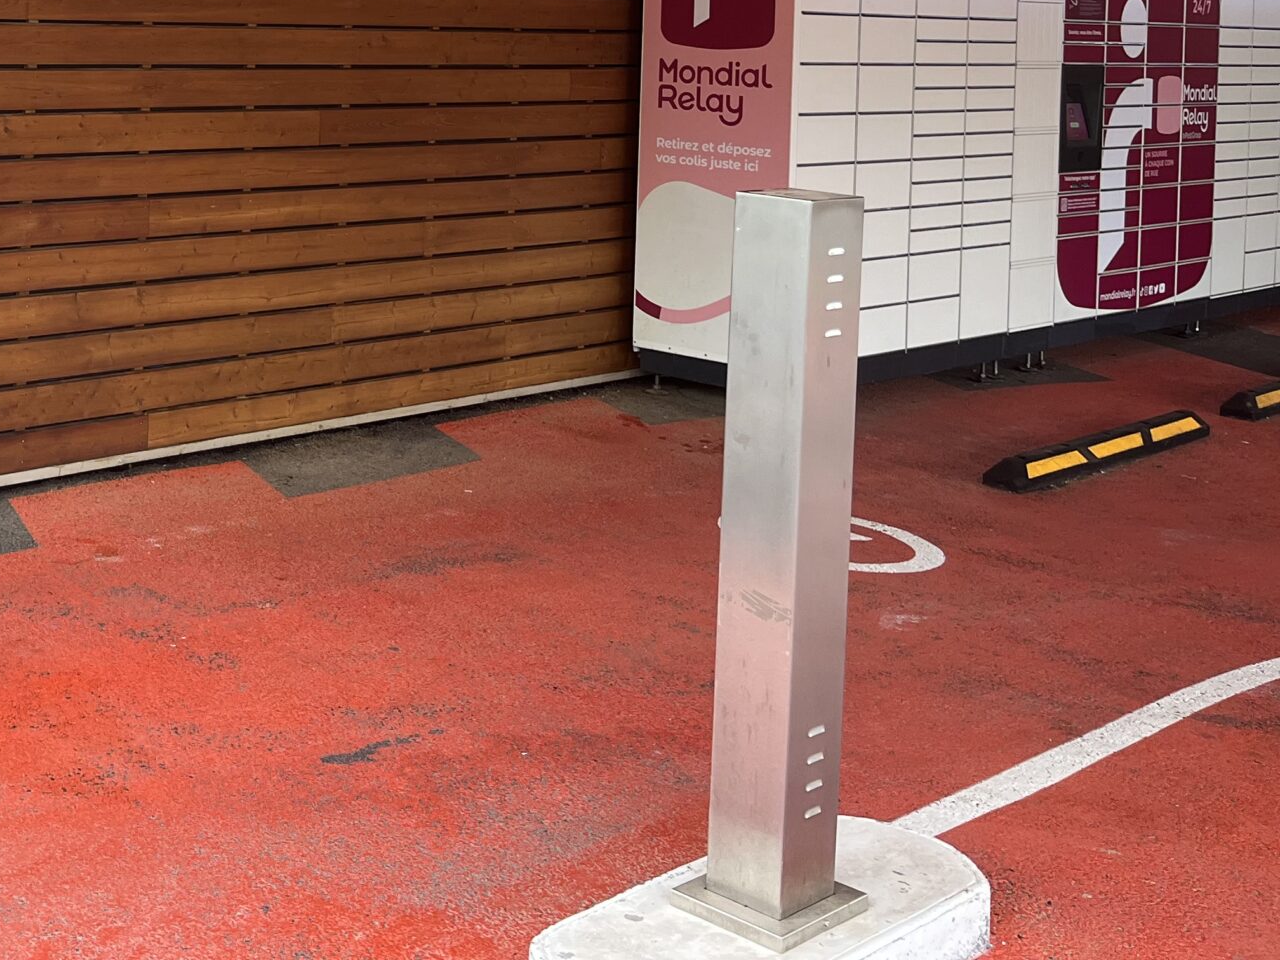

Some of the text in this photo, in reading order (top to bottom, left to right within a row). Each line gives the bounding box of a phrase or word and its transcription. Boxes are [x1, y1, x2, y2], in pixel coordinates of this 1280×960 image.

[658, 57, 773, 89] Mondial
[1183, 84, 1217, 102] Mondial
[657, 84, 744, 126] Relay
[1182, 108, 1209, 132] Relay
[656, 137, 772, 158] Retirez et déposez
[655, 154, 759, 172] vos colis juste ici
[1100, 287, 1136, 301] mondialrelay.fr
